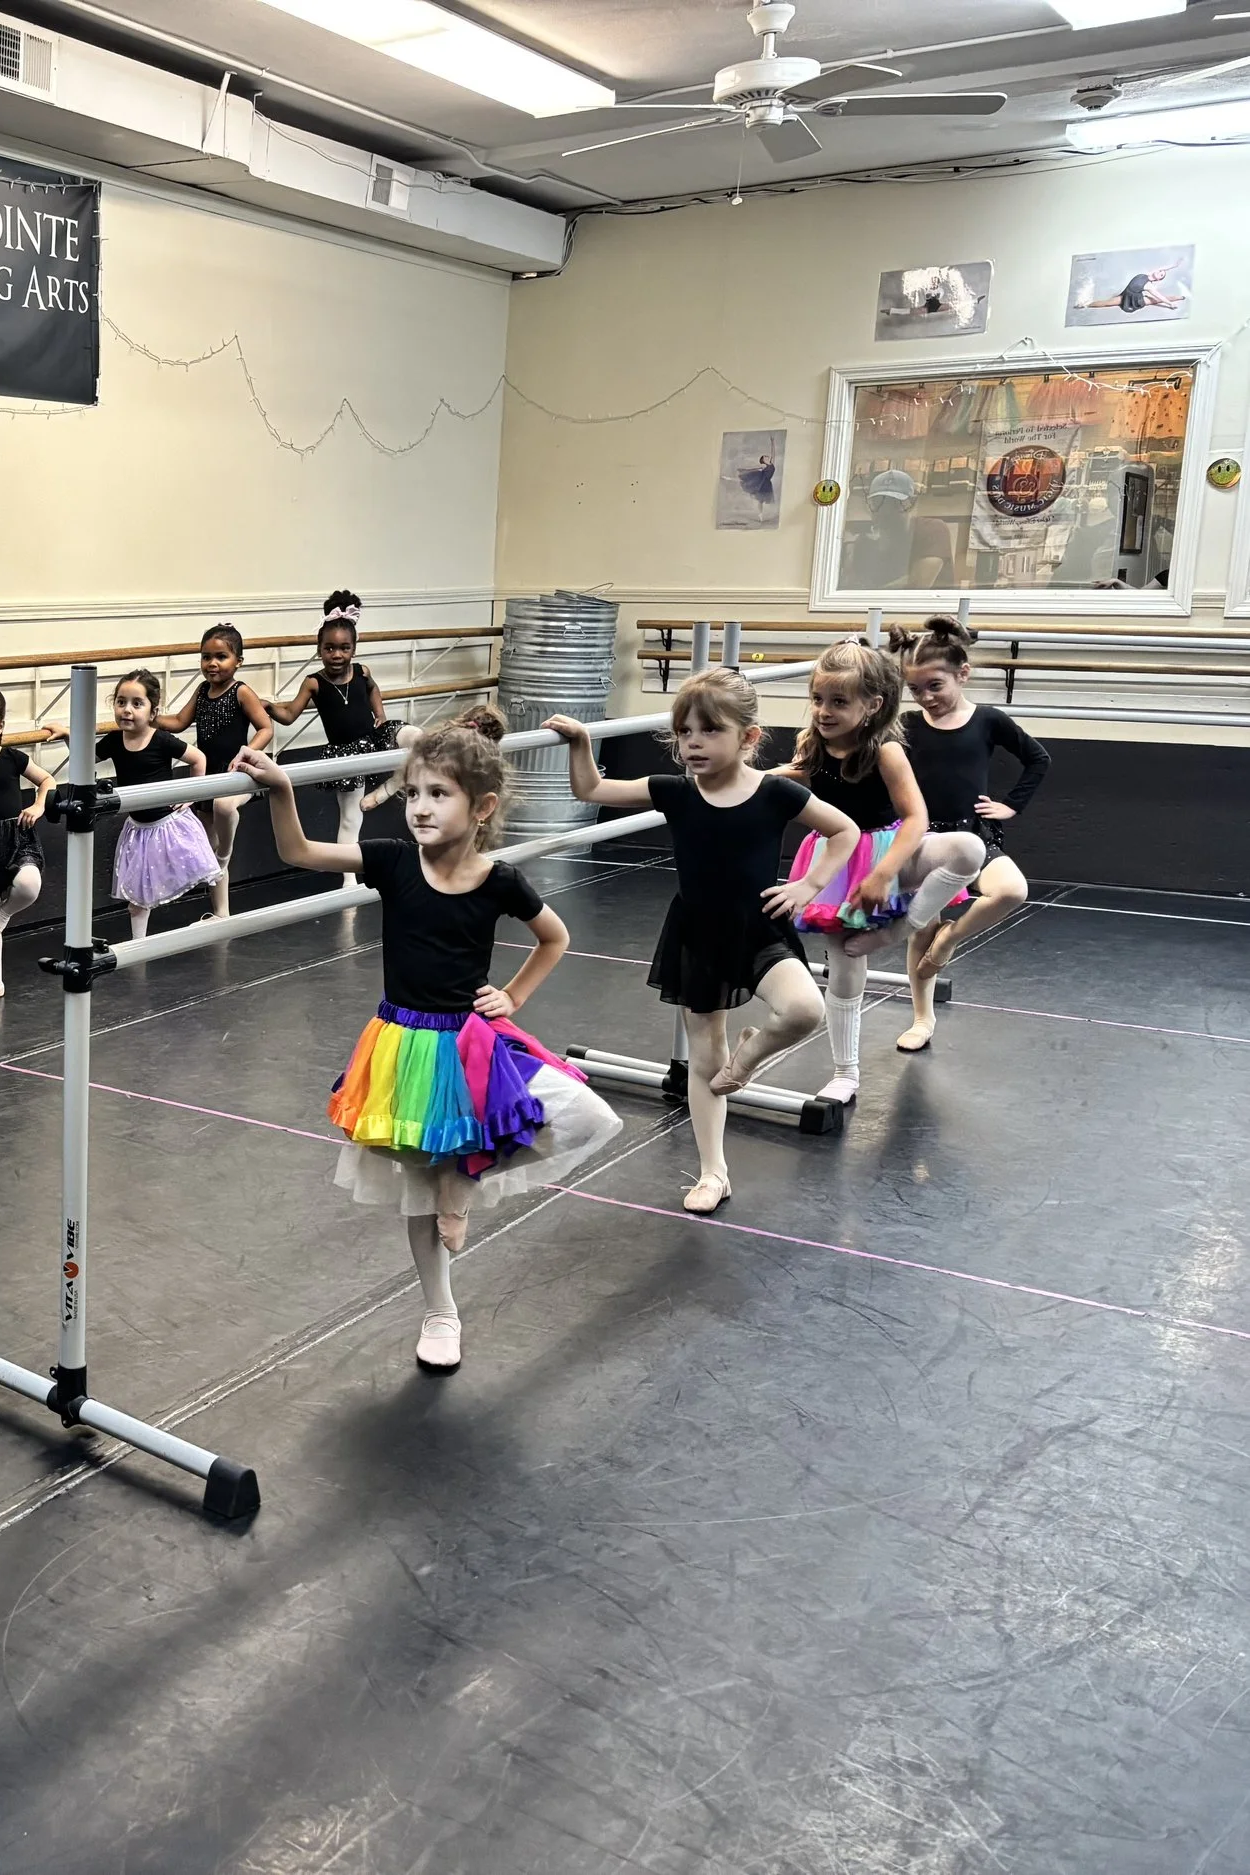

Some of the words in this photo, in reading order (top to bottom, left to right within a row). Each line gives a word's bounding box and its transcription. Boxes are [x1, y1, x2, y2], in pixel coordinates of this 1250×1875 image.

[21, 265, 90, 314] ARTS
[66, 1218, 75, 1260] VIBE
[65, 1280, 73, 1321] VITA
